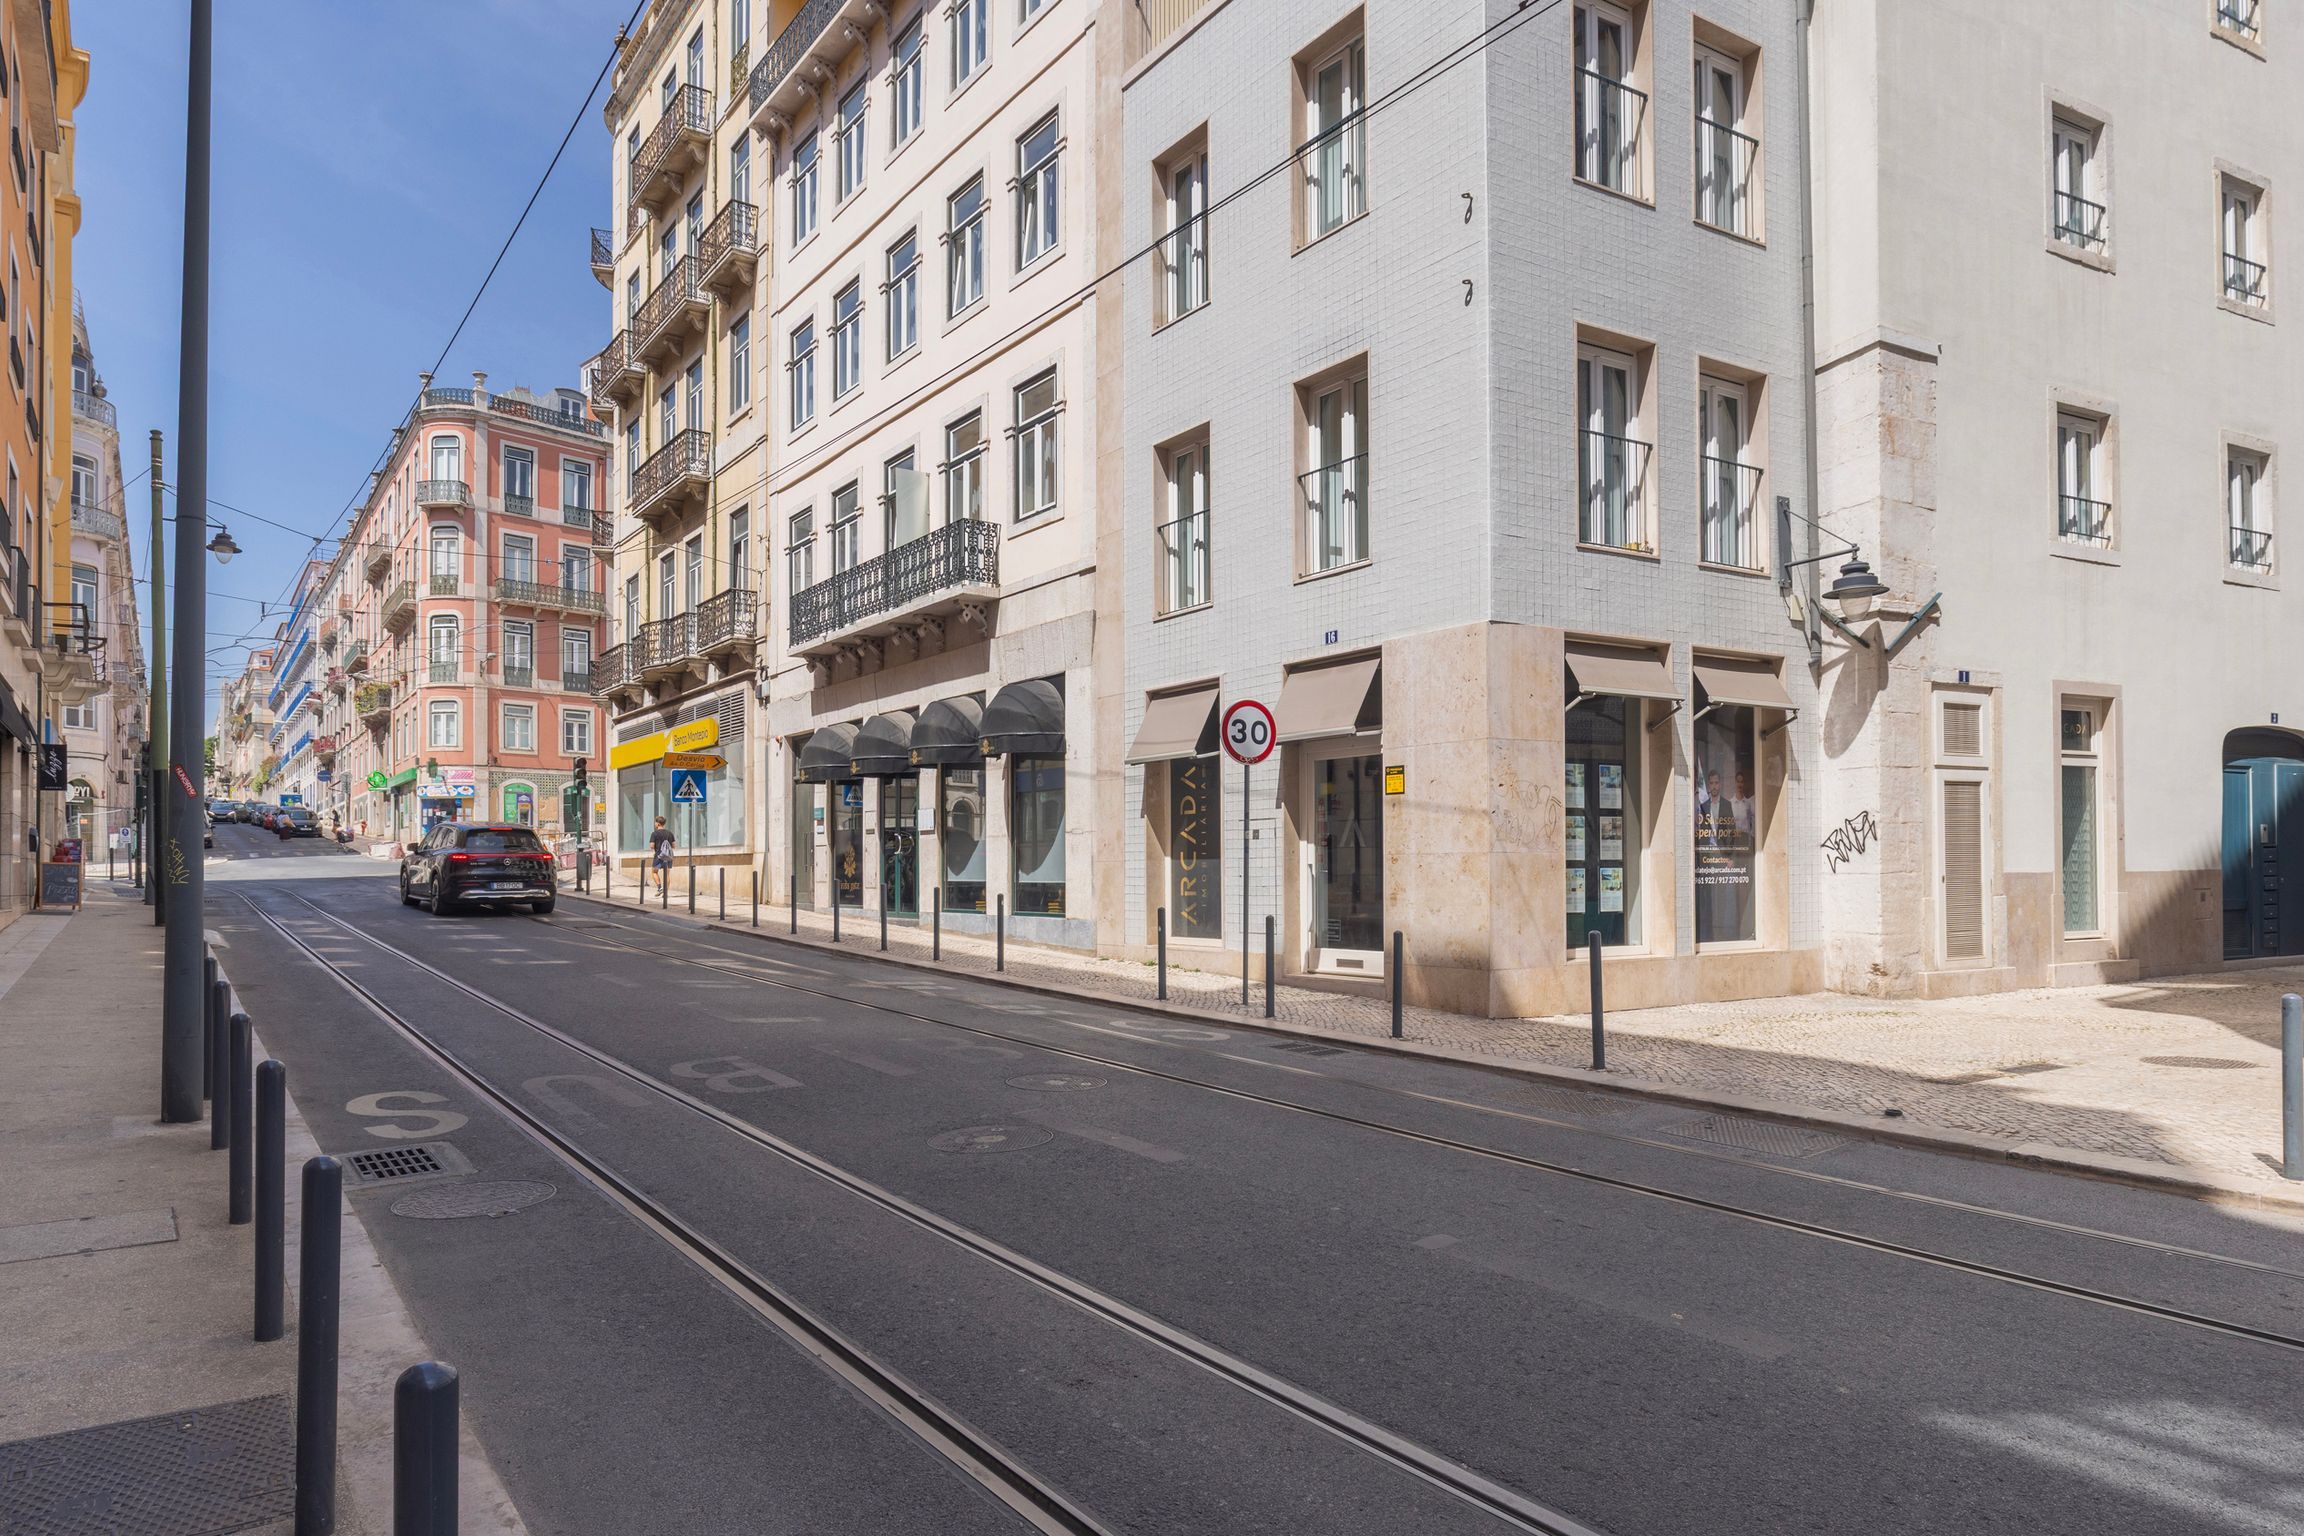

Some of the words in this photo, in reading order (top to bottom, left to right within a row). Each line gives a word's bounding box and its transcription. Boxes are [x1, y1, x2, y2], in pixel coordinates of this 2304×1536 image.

[1328, 631, 1336, 644] 16
[1231, 718, 1268, 745] 30
[1180, 766, 1198, 926] ARCADA
